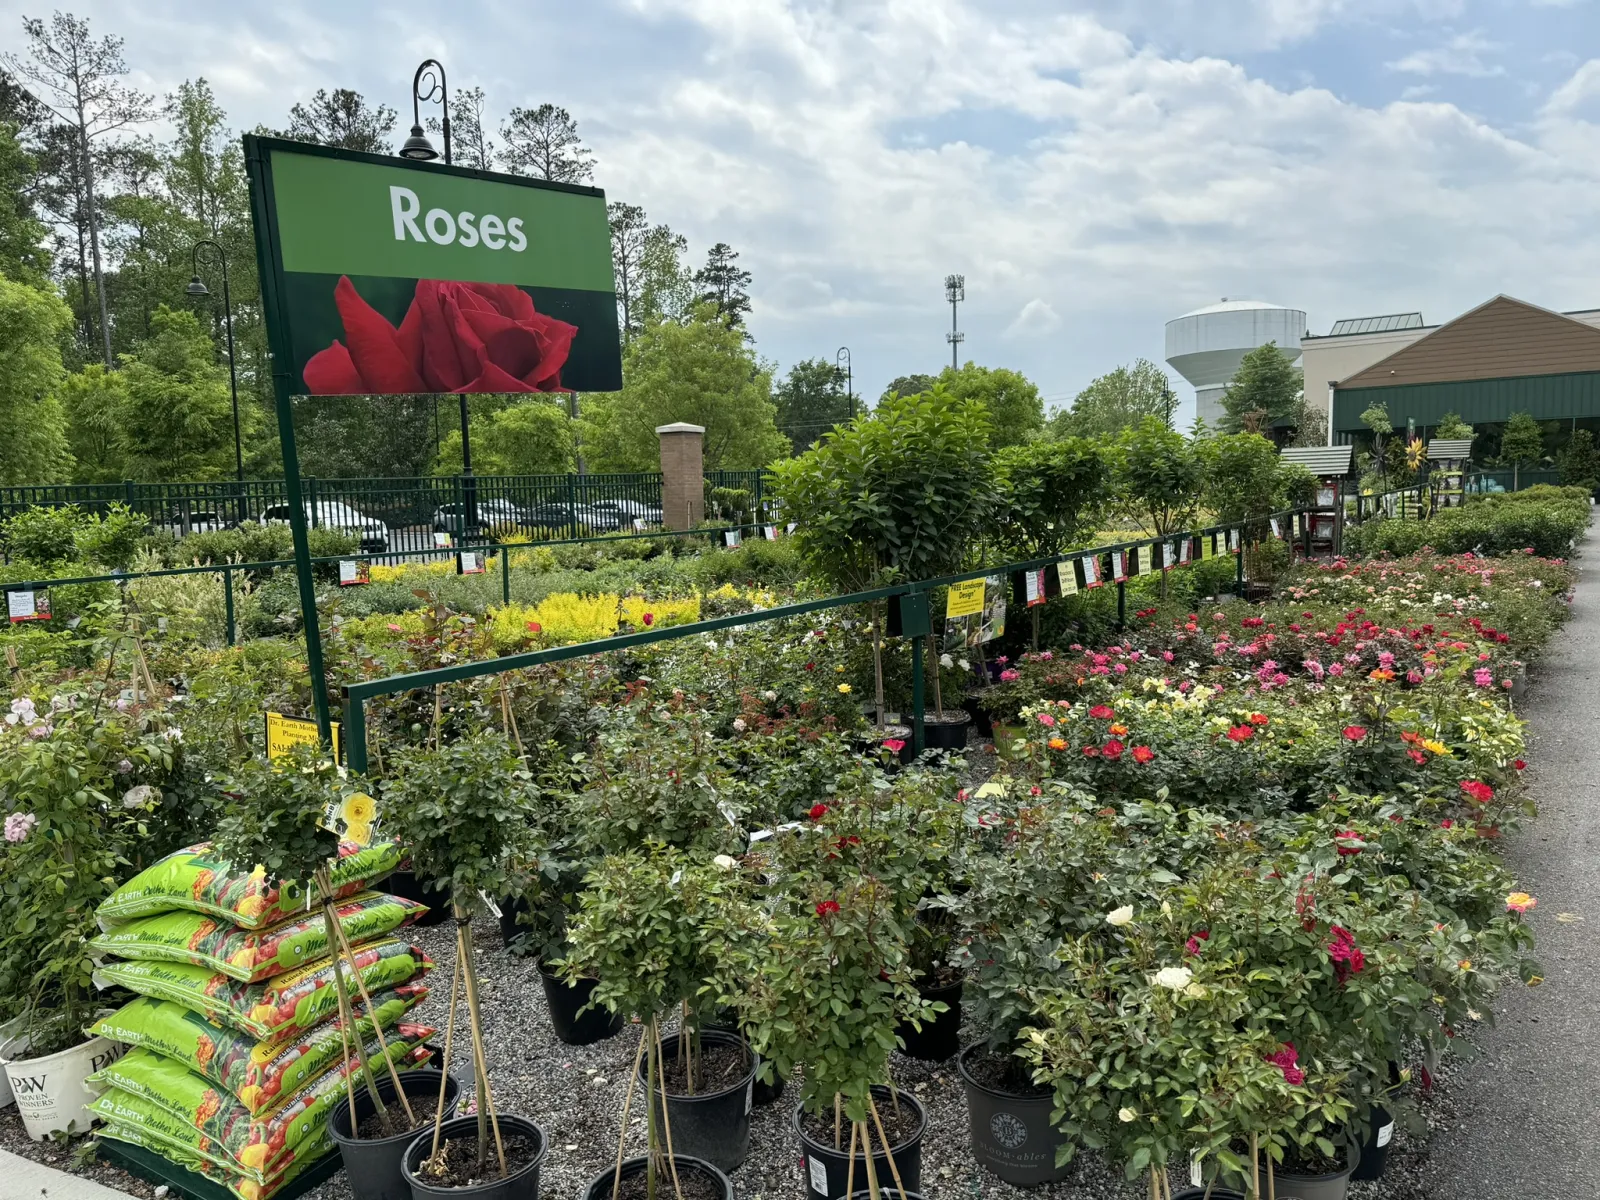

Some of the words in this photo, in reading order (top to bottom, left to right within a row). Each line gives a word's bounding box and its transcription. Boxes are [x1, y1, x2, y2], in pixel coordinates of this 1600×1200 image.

[390, 186, 528, 252] Roses
[281, 720, 298, 729] Earth
[282, 730, 307, 741] Planting
[103, 896, 115, 906] DR
[118, 890, 142, 902] EARTH
[122, 964, 150, 976] EARTH
[150, 967, 176, 982] Mother
[175, 975, 202, 988] Land
[100, 1024, 114, 1035] DR
[116, 1027, 143, 1040] EARTH
[144, 1033, 172, 1050] Mother
[172, 1044, 192, 1062] Land
[276, 1042, 298, 1059] CUBIC
[295, 1032, 312, 1045] FEET
[317, 1038, 333, 1051] DR
[10, 1074, 48, 1094] PW
[114, 1073, 143, 1091] EARTH
[144, 1084, 170, 1106] Mother
[279, 1094, 304, 1113] CUBIC
[301, 1083, 317, 1096] FEET
[322, 1089, 339, 1103] DR
[100, 1099, 114, 1111] DR
[114, 1104, 145, 1122] EARTH
[144, 1114, 172, 1134] Mother
[172, 1127, 196, 1144] Land
[106, 1123, 119, 1134] DR
